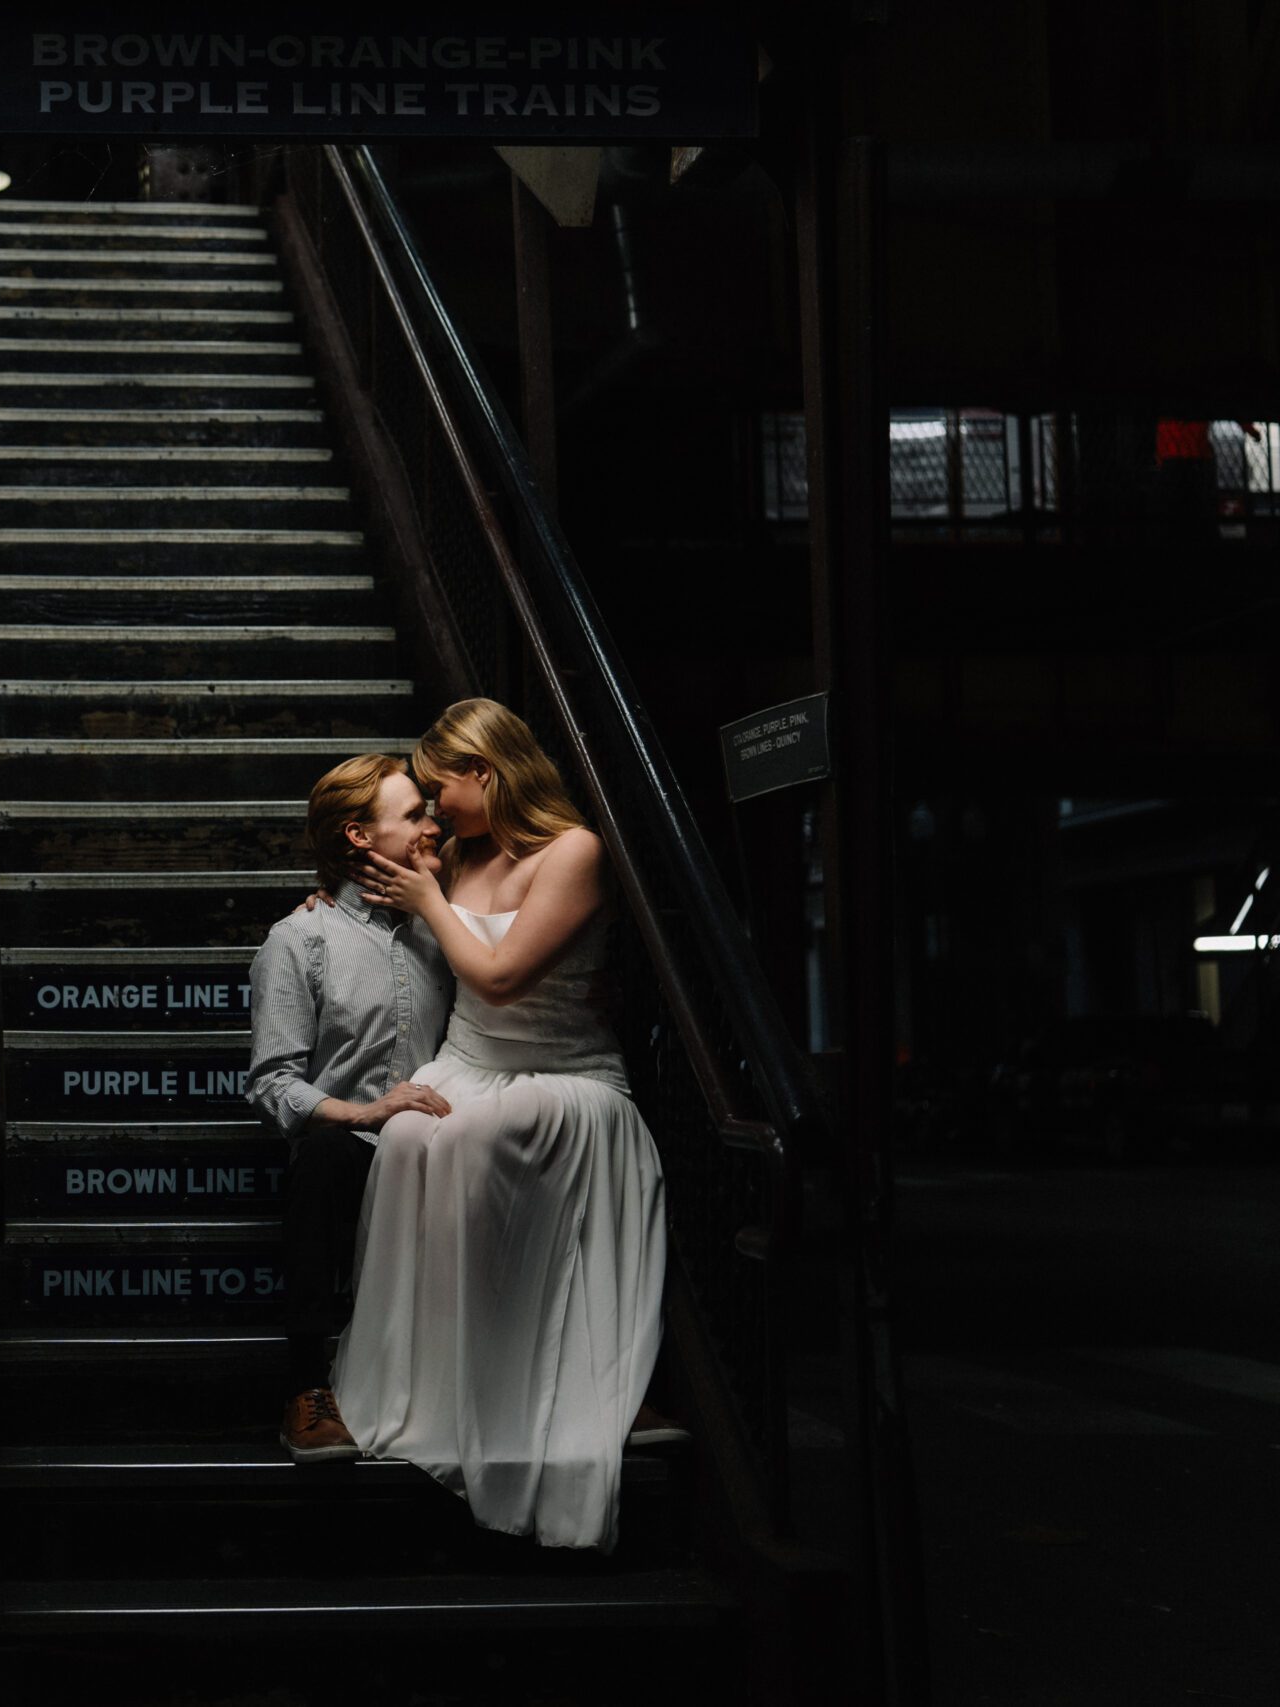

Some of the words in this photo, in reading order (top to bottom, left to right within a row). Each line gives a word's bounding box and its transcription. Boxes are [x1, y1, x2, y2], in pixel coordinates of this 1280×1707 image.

[32, 33, 667, 71] BROWN-ORANGE-PINK
[39, 80, 270, 115] PURPLE
[292, 82, 426, 116] LINE
[444, 83, 662, 117] TRAINS
[776, 731, 801, 749] QUINCY
[36, 984, 158, 1010] ORANGE
[167, 984, 230, 1009] LINE
[237, 984, 252, 1009] T
[63, 1070, 179, 1096] PURPLE
[65, 1168, 178, 1195] BROWN
[186, 1168, 256, 1193] LINE
[264, 1167, 285, 1193] T
[42, 1268, 116, 1297] PINK
[121, 1268, 192, 1296] LINE
[199, 1267, 246, 1296] TO
